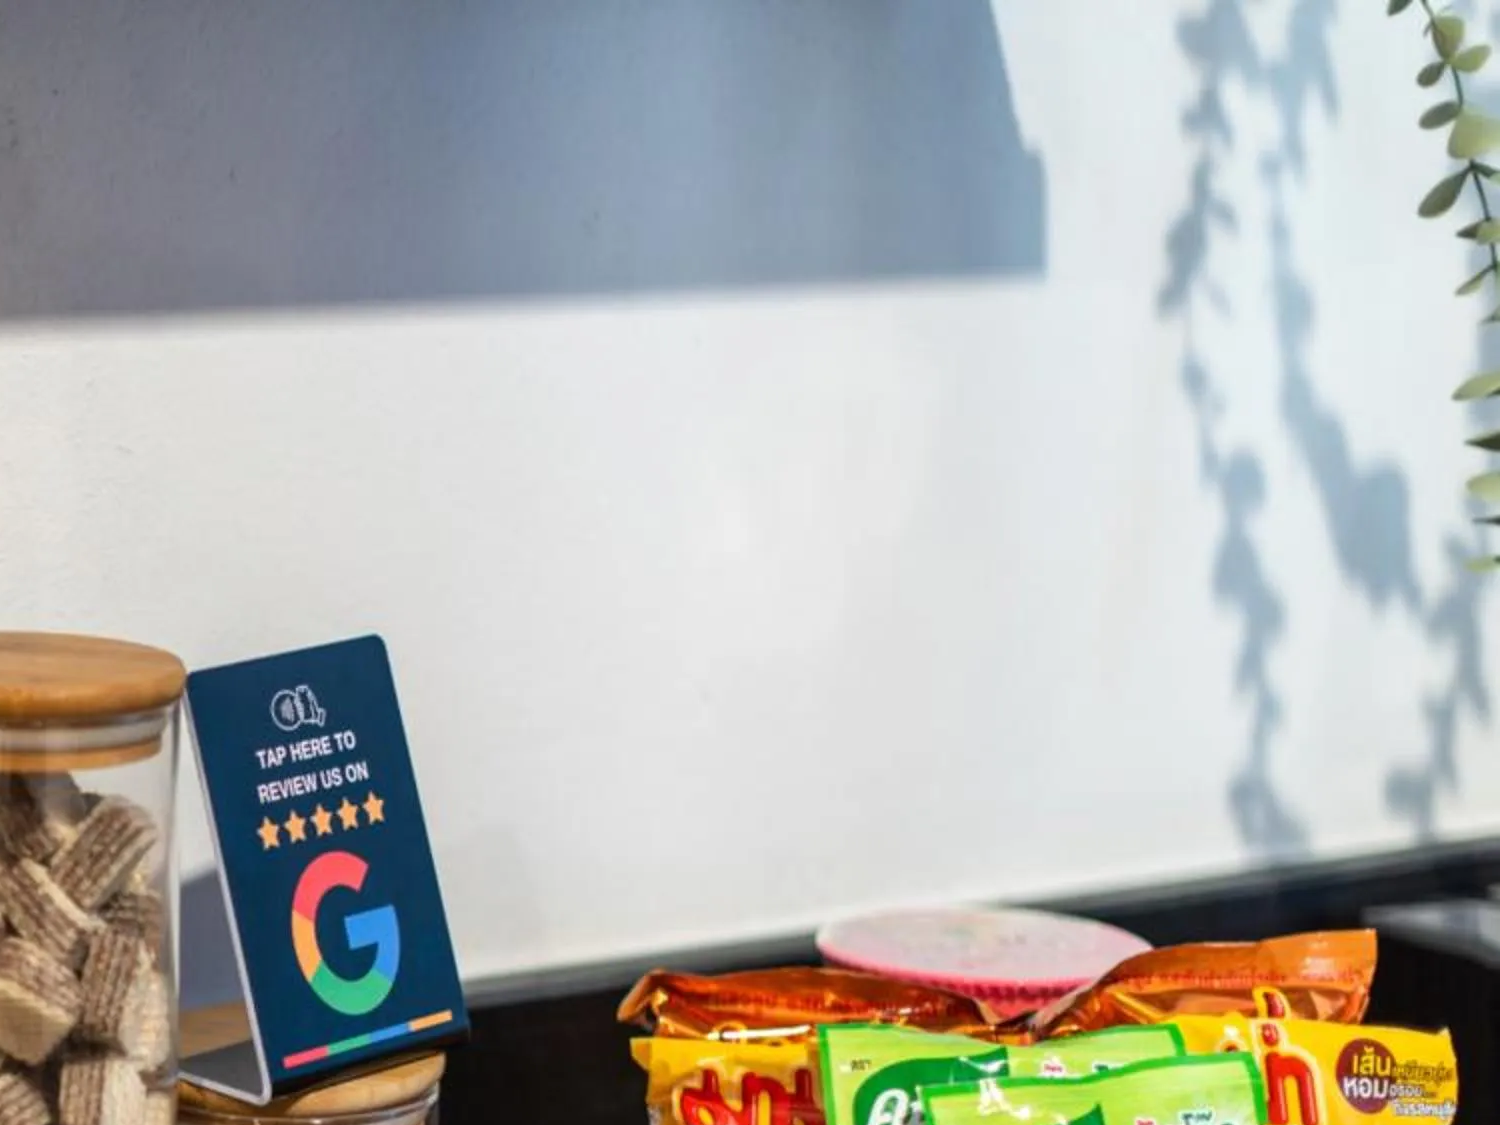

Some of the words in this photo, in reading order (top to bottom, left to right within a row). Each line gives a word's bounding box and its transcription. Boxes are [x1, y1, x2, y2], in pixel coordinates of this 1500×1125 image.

[255, 745, 287, 769] TAP
[288, 735, 333, 762] HERE
[334, 729, 356, 752] TO
[257, 772, 318, 804] REVIEW
[320, 766, 343, 789] US
[345, 760, 369, 783] ON
[290, 850, 400, 1016] G
